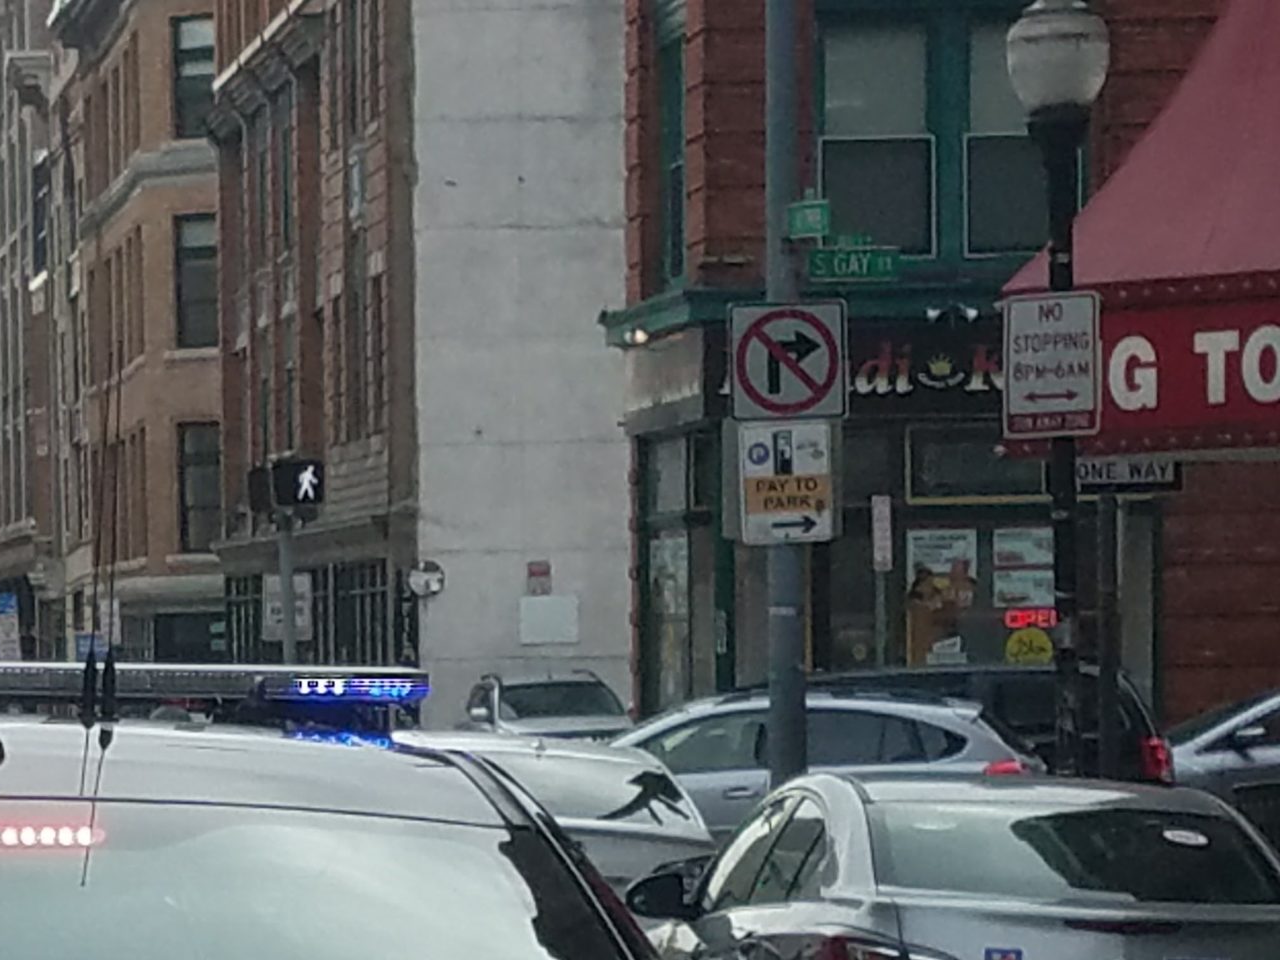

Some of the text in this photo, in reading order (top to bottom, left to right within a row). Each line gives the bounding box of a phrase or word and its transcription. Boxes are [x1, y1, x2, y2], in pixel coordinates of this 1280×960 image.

[814, 254, 826, 275] S
[833, 252, 871, 276] GAY
[1038, 302, 1063, 322] NO
[1013, 331, 1090, 355] STOPPING
[1076, 460, 1170, 481] ONE WAY
[756, 477, 818, 493] PAY TO
[763, 496, 811, 511] PARK
